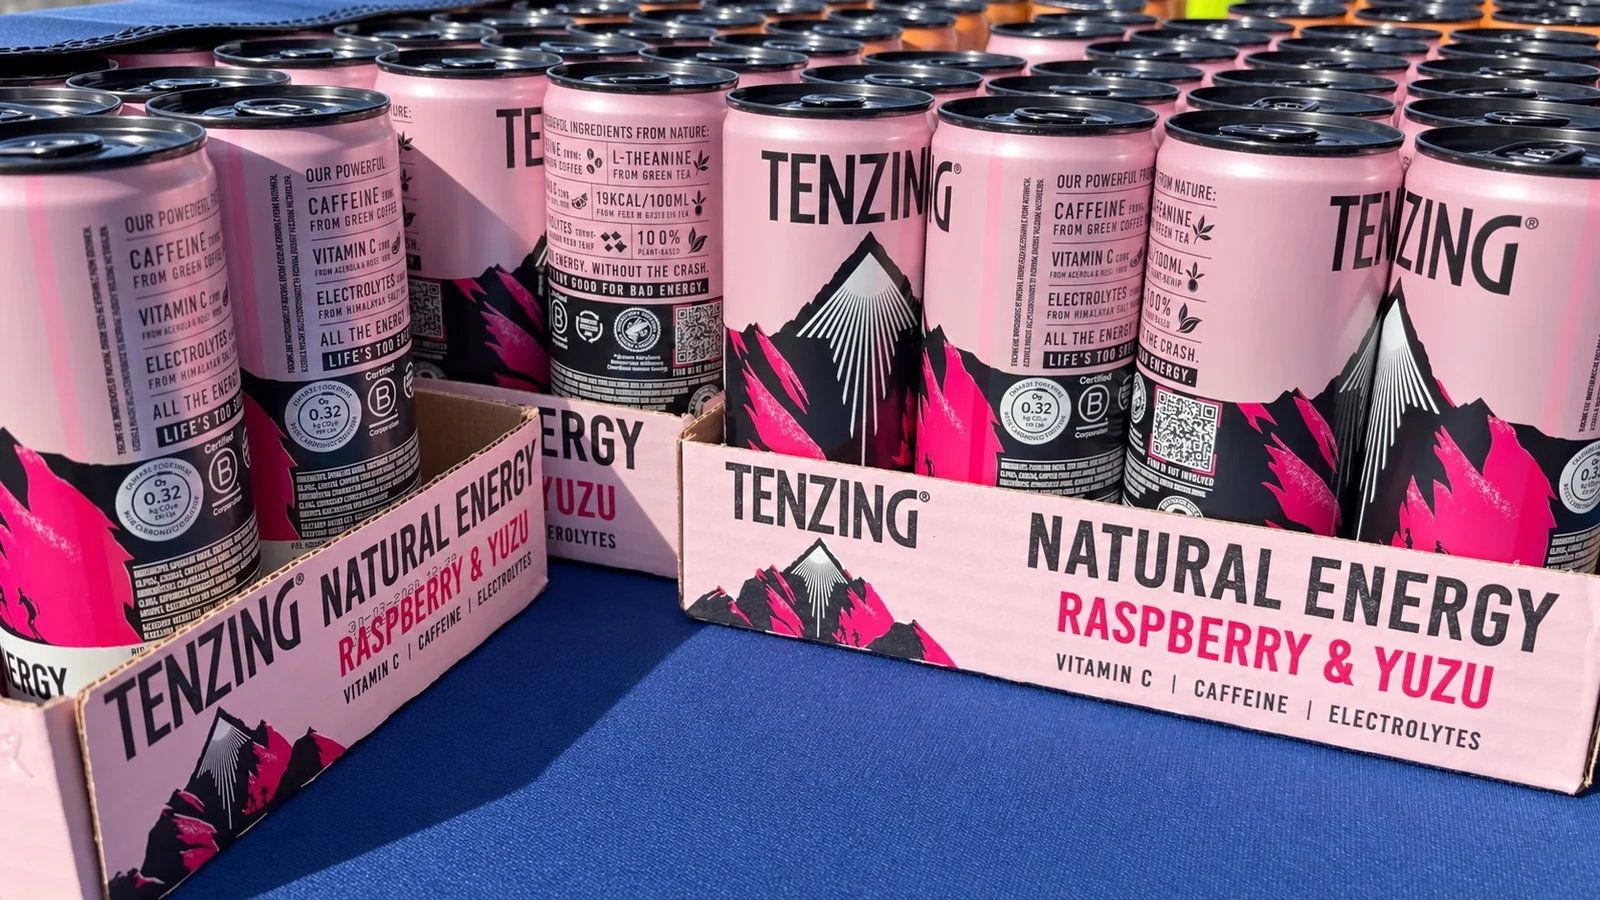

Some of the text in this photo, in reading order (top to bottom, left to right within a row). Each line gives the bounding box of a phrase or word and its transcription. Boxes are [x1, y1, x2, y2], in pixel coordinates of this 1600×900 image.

[570, 121, 633, 139] INGREDIENTS
[636, 127, 666, 140] FROM
[670, 125, 710, 139] NATURE:
[306, 156, 386, 183] OUR POWERFUL
[613, 150, 692, 166] L-THEANINE
[613, 169, 691, 180] FROM GREEN TEA
[1057, 174, 1082, 189] OUR
[1085, 170, 1137, 188] POWERFUL
[308, 186, 379, 216] CAFFEINE
[596, 191, 689, 208] 19KCAL/100ML
[1174, 179, 1216, 202] NATURE:
[310, 217, 340, 232] FROM
[344, 210, 374, 227] GREEN
[1054, 199, 1126, 220] CAFFEINE
[125, 213, 155, 234] OUR
[1053, 224, 1082, 236] FROM
[1087, 220, 1118, 235] GREEN
[637, 229, 680, 246] 100%
[1175, 229, 1190, 245] TEA
[129, 231, 207, 271] CAFFEINE
[313, 238, 376, 265] VITAMIN C
[1052, 248, 1114, 267] VITAMIN C
[133, 270, 167, 289] FROM
[172, 259, 202, 280] GREEN
[592, 261, 642, 278] WITHOUT
[647, 265, 669, 278] THE
[674, 261, 709, 277] CRASH.
[1049, 271, 1066, 279] FROM
[317, 273, 395, 306] ELECTROLYTES
[571, 276, 597, 292] GOOD
[602, 282, 624, 296] FOR
[630, 284, 654, 297] BAD
[660, 281, 706, 296] ENERGY.
[1048, 286, 1128, 307] ELECTROLYTES
[138, 294, 197, 326] VITAMIN
[199, 291, 207, 309] C
[319, 307, 343, 320] FROM
[346, 296, 386, 315] HIMALAYAN
[1047, 310, 1070, 320] FROM
[1074, 307, 1114, 319] HIMALAYAN
[320, 309, 405, 347] ALL THE ENERGY
[1044, 332, 1067, 346] ALL
[1073, 330, 1095, 345] THE
[145, 329, 228, 374] ELECTROLYTES
[329, 346, 372, 368] LIFE'S
[375, 338, 394, 354] TOO
[1049, 352, 1092, 366] LIFE'S
[1096, 348, 1116, 363] TOO
[1146, 329, 1159, 349] THE
[1160, 338, 1199, 364] CRASH.
[148, 373, 177, 390] FROM
[180, 358, 221, 381] HIMALAYAN
[1149, 355, 1192, 384] ENERGY.
[153, 399, 180, 421] ALL
[184, 388, 209, 411] THE
[309, 405, 342, 421] 0.32
[1021, 402, 1052, 415] 0.32
[163, 404, 232, 444] LIFE'S TOO
[143, 485, 182, 506] 0.32
[320, 503, 450, 628] NATURAL
[455, 438, 536, 538] ENERGY
[338, 555, 464, 678] RASPBERRY
[469, 546, 484, 582] &
[487, 509, 529, 567] YUZU
[1027, 512, 1560, 653] NATURAL ENERGY
[343, 660, 389, 704] VITAMIN
[393, 653, 399, 670] C
[418, 607, 461, 651] CAFFEINE
[477, 551, 532, 606] ELECTROLYTES
[1057, 591, 1494, 709] RASPBERRY & YUZU
[1056, 653, 1482, 751] VITAMIN C CAFFEINE ELECTROLYTES
